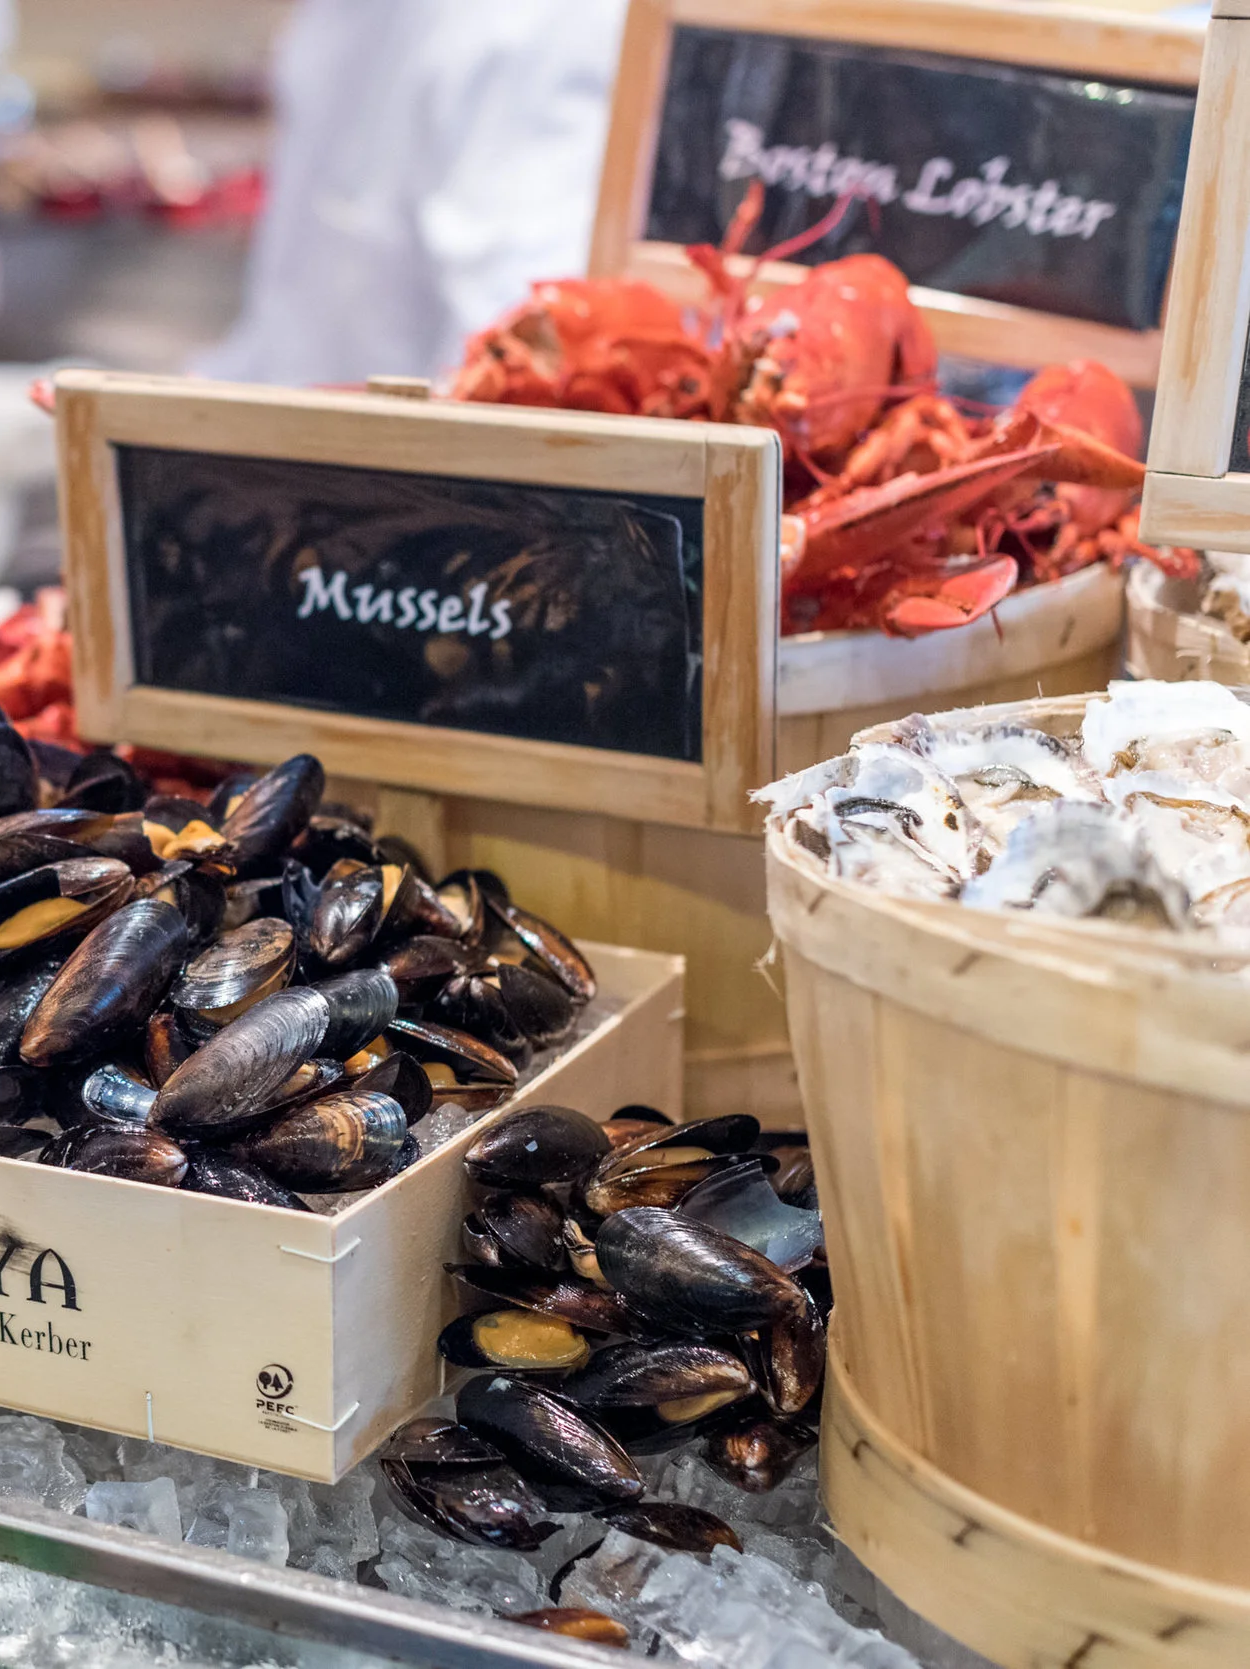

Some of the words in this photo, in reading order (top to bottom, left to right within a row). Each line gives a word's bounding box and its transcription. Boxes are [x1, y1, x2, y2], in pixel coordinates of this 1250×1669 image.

[719, 117, 898, 204] Boston
[903, 156, 1117, 240] Lobster
[297, 565, 514, 640] Mussels
[256, 1398, 295, 1416] PEFC
